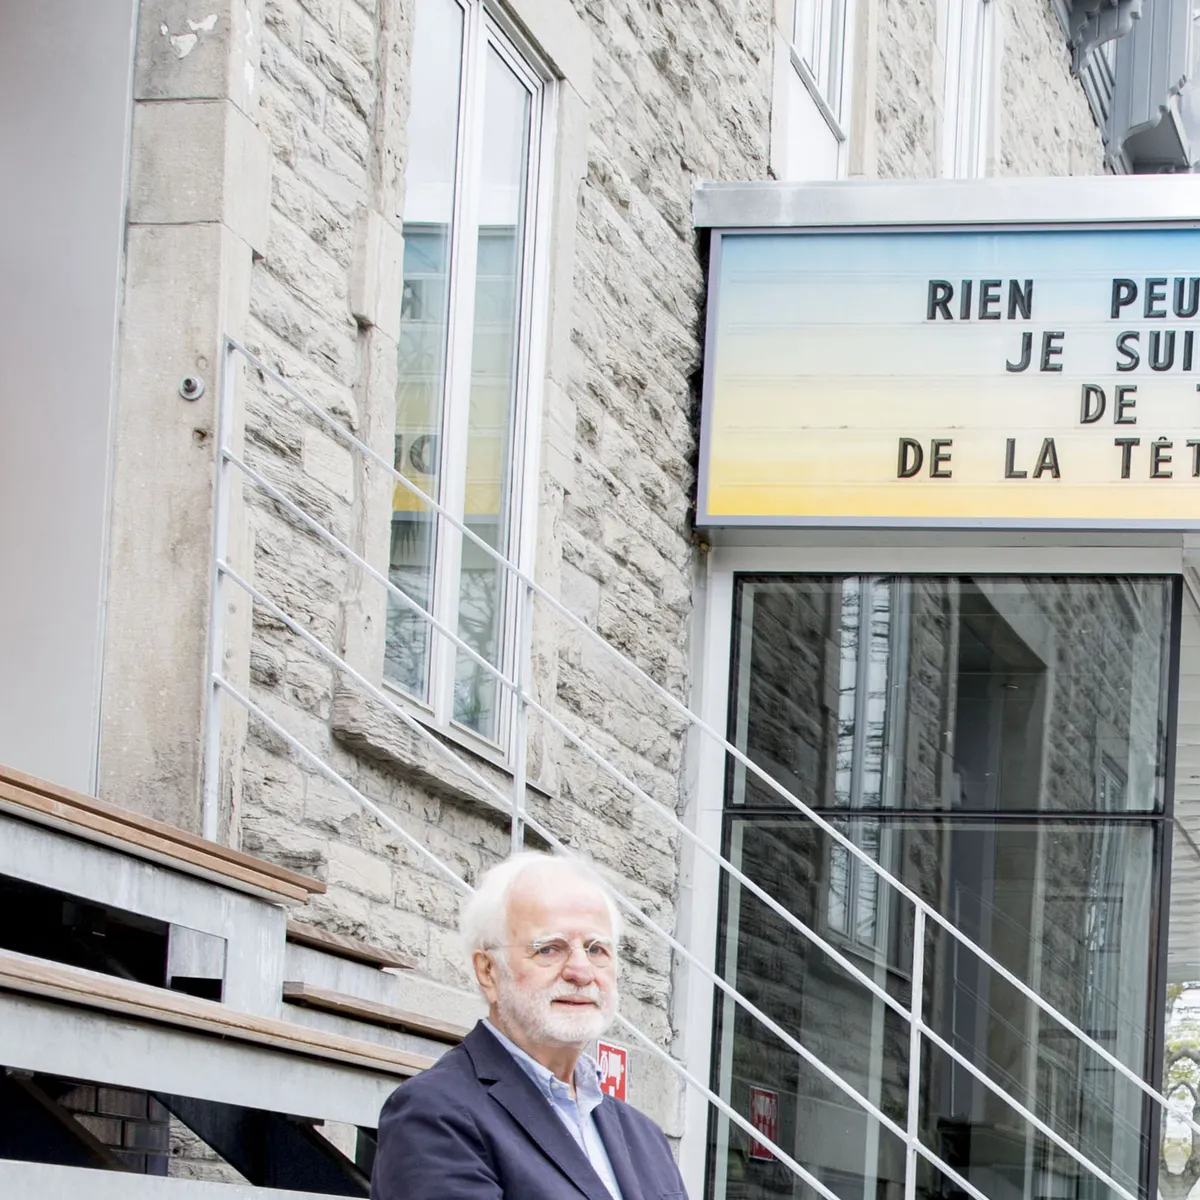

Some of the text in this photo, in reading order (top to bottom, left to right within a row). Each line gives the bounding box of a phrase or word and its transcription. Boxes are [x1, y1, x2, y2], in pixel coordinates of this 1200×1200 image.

[926, 279, 1034, 320] RIEN
[1006, 331, 1065, 373] JE
[1080, 383, 1138, 425] DE
[897, 437, 953, 479] DE
[1004, 437, 1061, 479] LA
